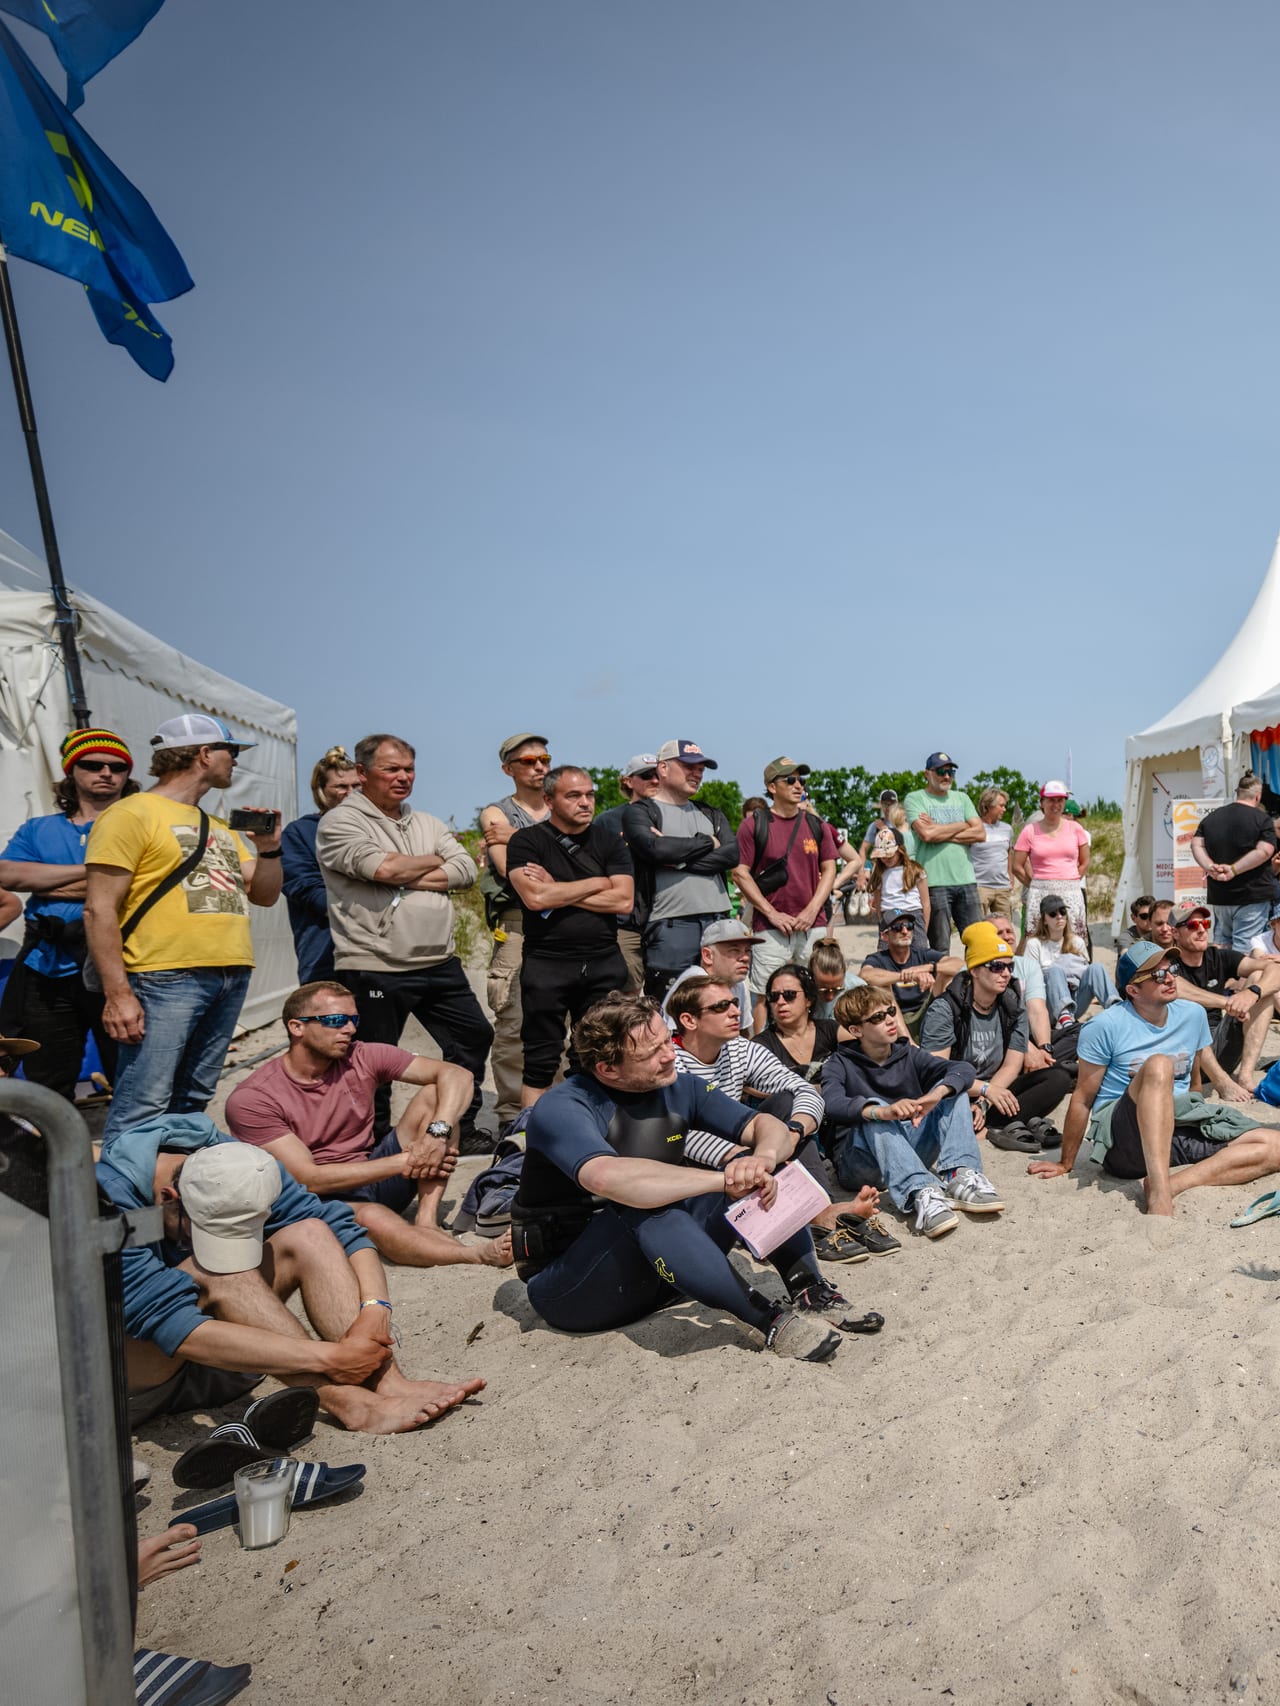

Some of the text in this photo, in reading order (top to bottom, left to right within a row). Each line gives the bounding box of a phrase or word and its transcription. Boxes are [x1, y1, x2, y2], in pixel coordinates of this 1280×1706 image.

[1156, 870, 1174, 878] SUPPO
[666, 1133, 683, 1143] XCEL
[733, 1208, 747, 1222] surf
